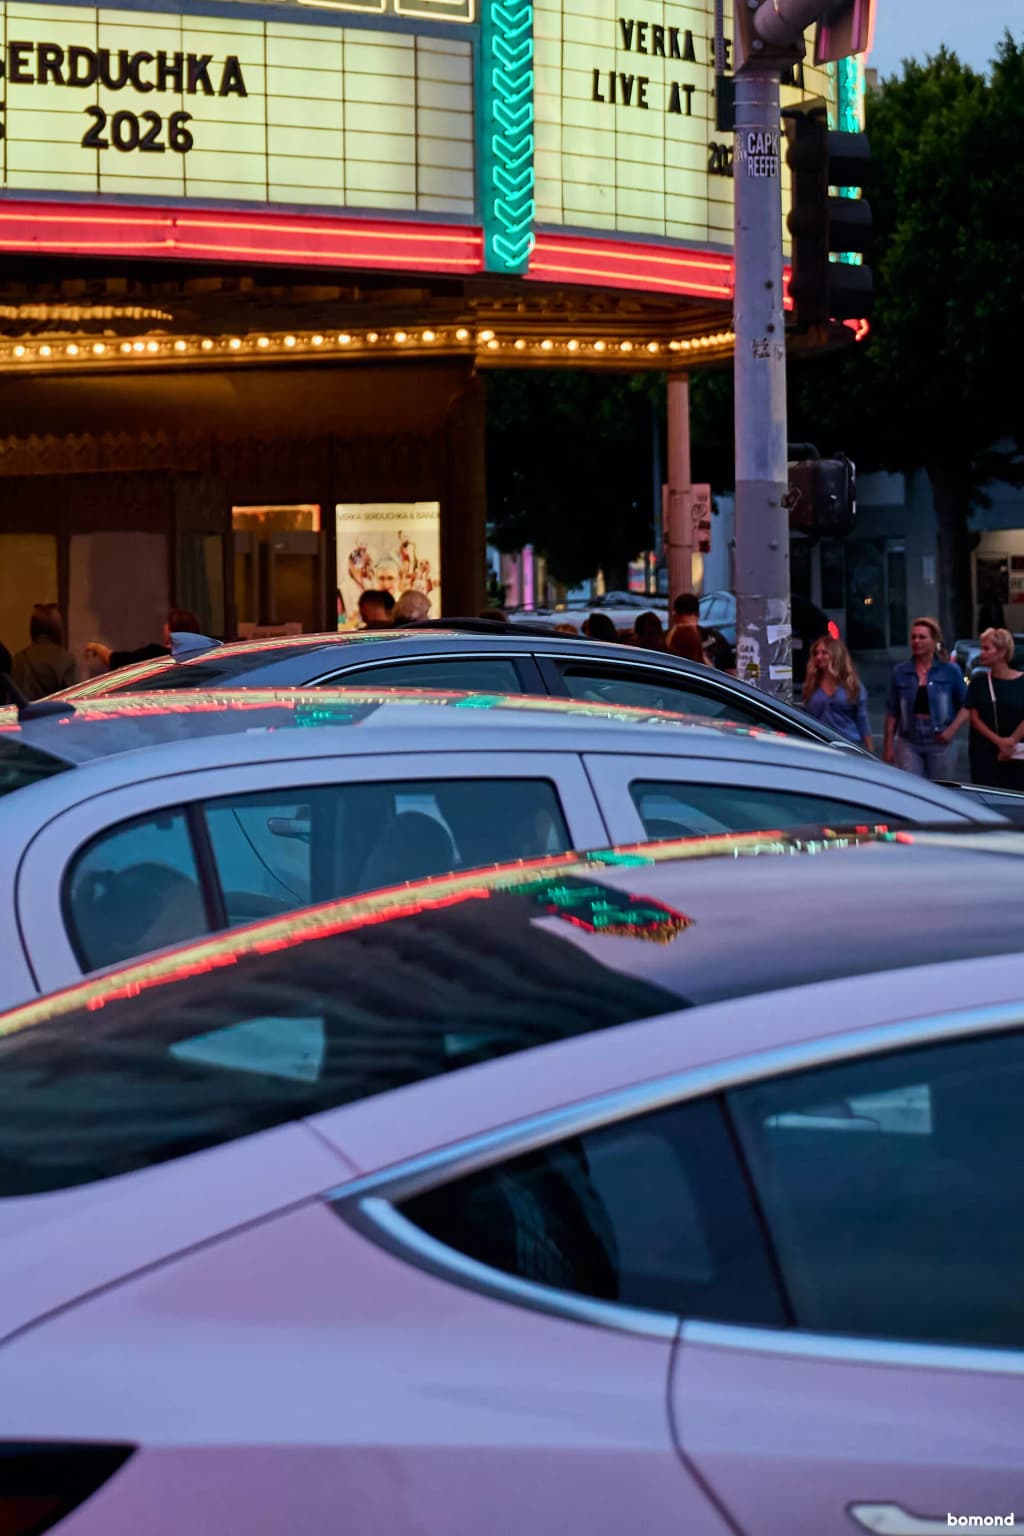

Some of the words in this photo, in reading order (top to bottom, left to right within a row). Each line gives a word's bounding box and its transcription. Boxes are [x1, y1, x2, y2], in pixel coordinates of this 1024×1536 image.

[619, 17, 697, 64] VERKA
[592, 67, 650, 111] LIVE
[667, 81, 696, 117] AT
[80, 104, 195, 155] 2026
